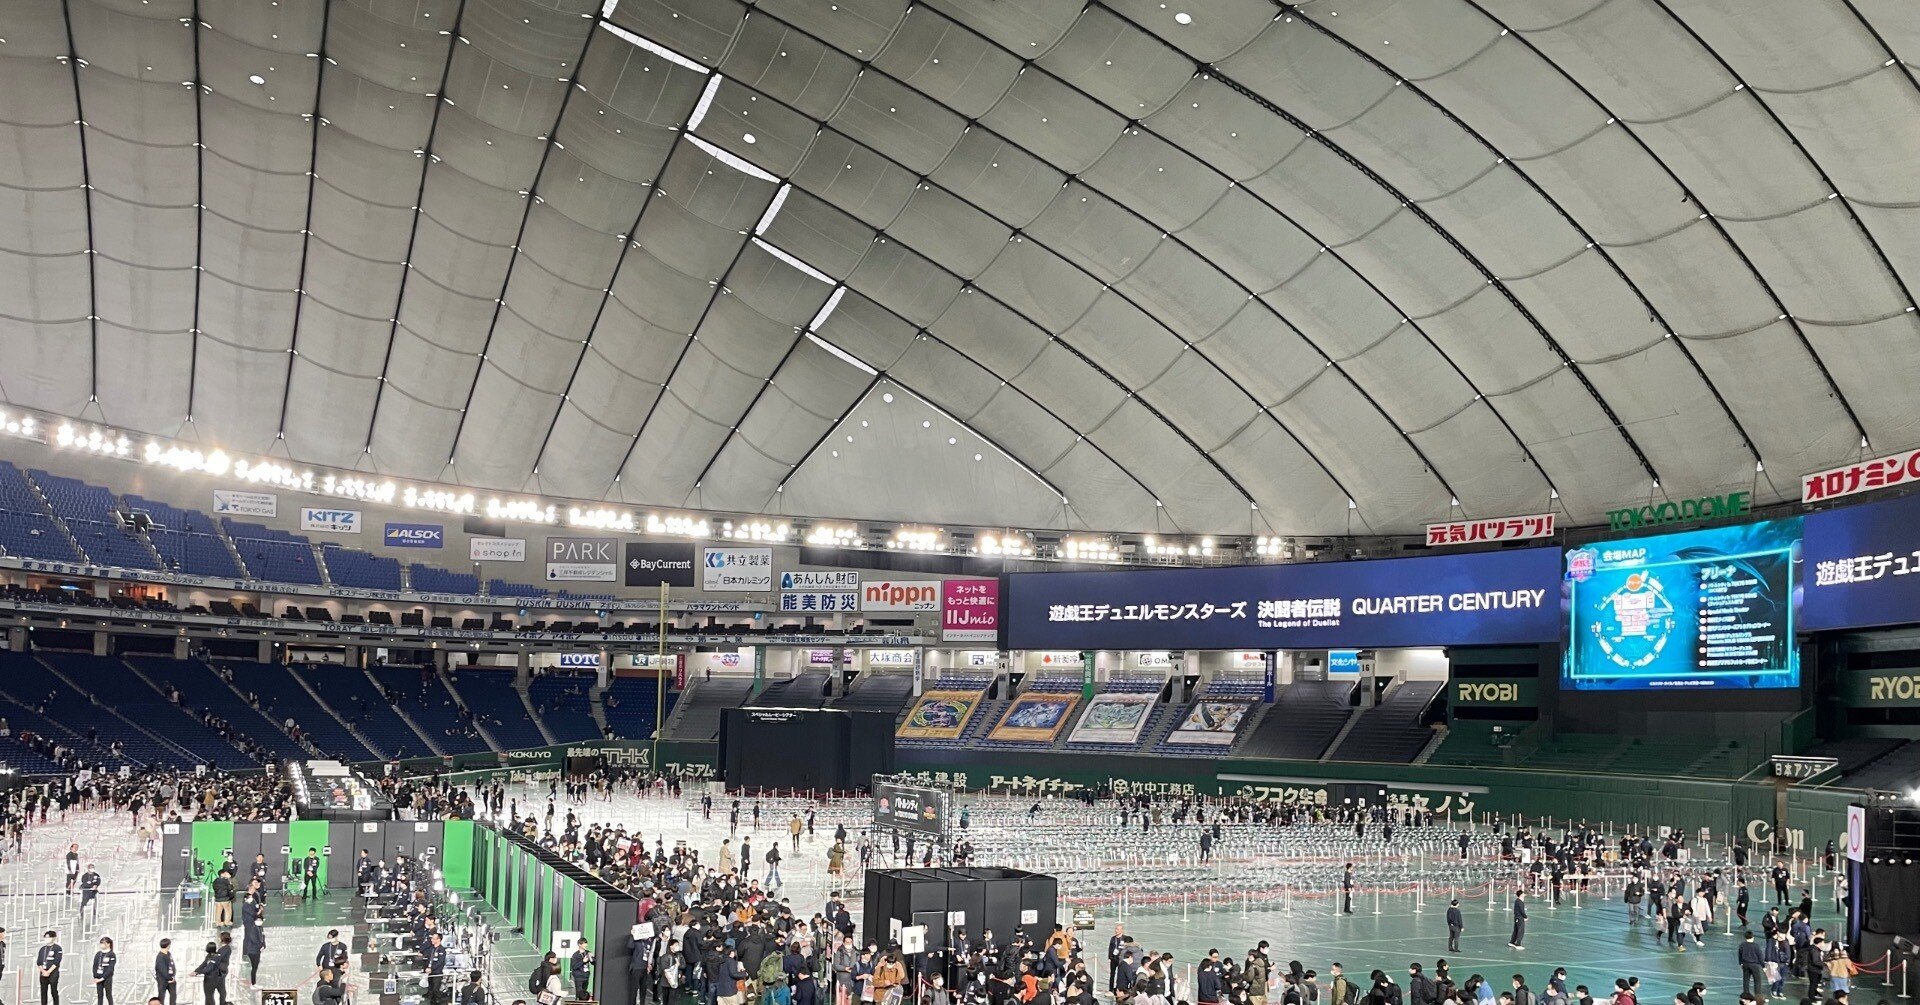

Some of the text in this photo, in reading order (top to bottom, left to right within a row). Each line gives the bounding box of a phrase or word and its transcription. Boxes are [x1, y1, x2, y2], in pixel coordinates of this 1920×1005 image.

[308, 511, 354, 523] KITZ
[1606, 491, 1751, 532] TOKYO DOME
[398, 530, 441, 539] ALSOK
[1428, 513, 1554, 544] 元気ハツラツ!
[553, 542, 610, 561] PARK
[640, 559, 691, 570] BayCurrent
[723, 576, 770, 585] 日本カルミック
[793, 573, 857, 585] あんしん財団
[866, 582, 936, 605] nippn
[955, 585, 987, 594] ネットを
[515, 600, 551, 608] DUSKIN
[556, 600, 591, 609] DUSKIN
[686, 603, 740, 611] パラマウントベッド
[782, 594, 856, 611] 能美防災
[947, 596, 995, 606] もっと快適に
[1352, 588, 1546, 615] QUARTER CENTURY
[1048, 598, 1341, 622] 遊戯王デュエルモンスターズ 決闘者伝説
[1274, 621, 1300, 629] Legend
[871, 652, 913, 664] 大塚商会
[1361, 663, 1370, 672] 16
[1458, 683, 1517, 701] RYOBI
[509, 750, 552, 759] KOKUYO
[567, 748, 649, 765] 最先端の THK
[898, 770, 968, 788] 大成建設
[990, 775, 1084, 792] アートネイチャー
[1130, 780, 1195, 796] 竹中工務店
[1255, 786, 1327, 805] フコク生命
